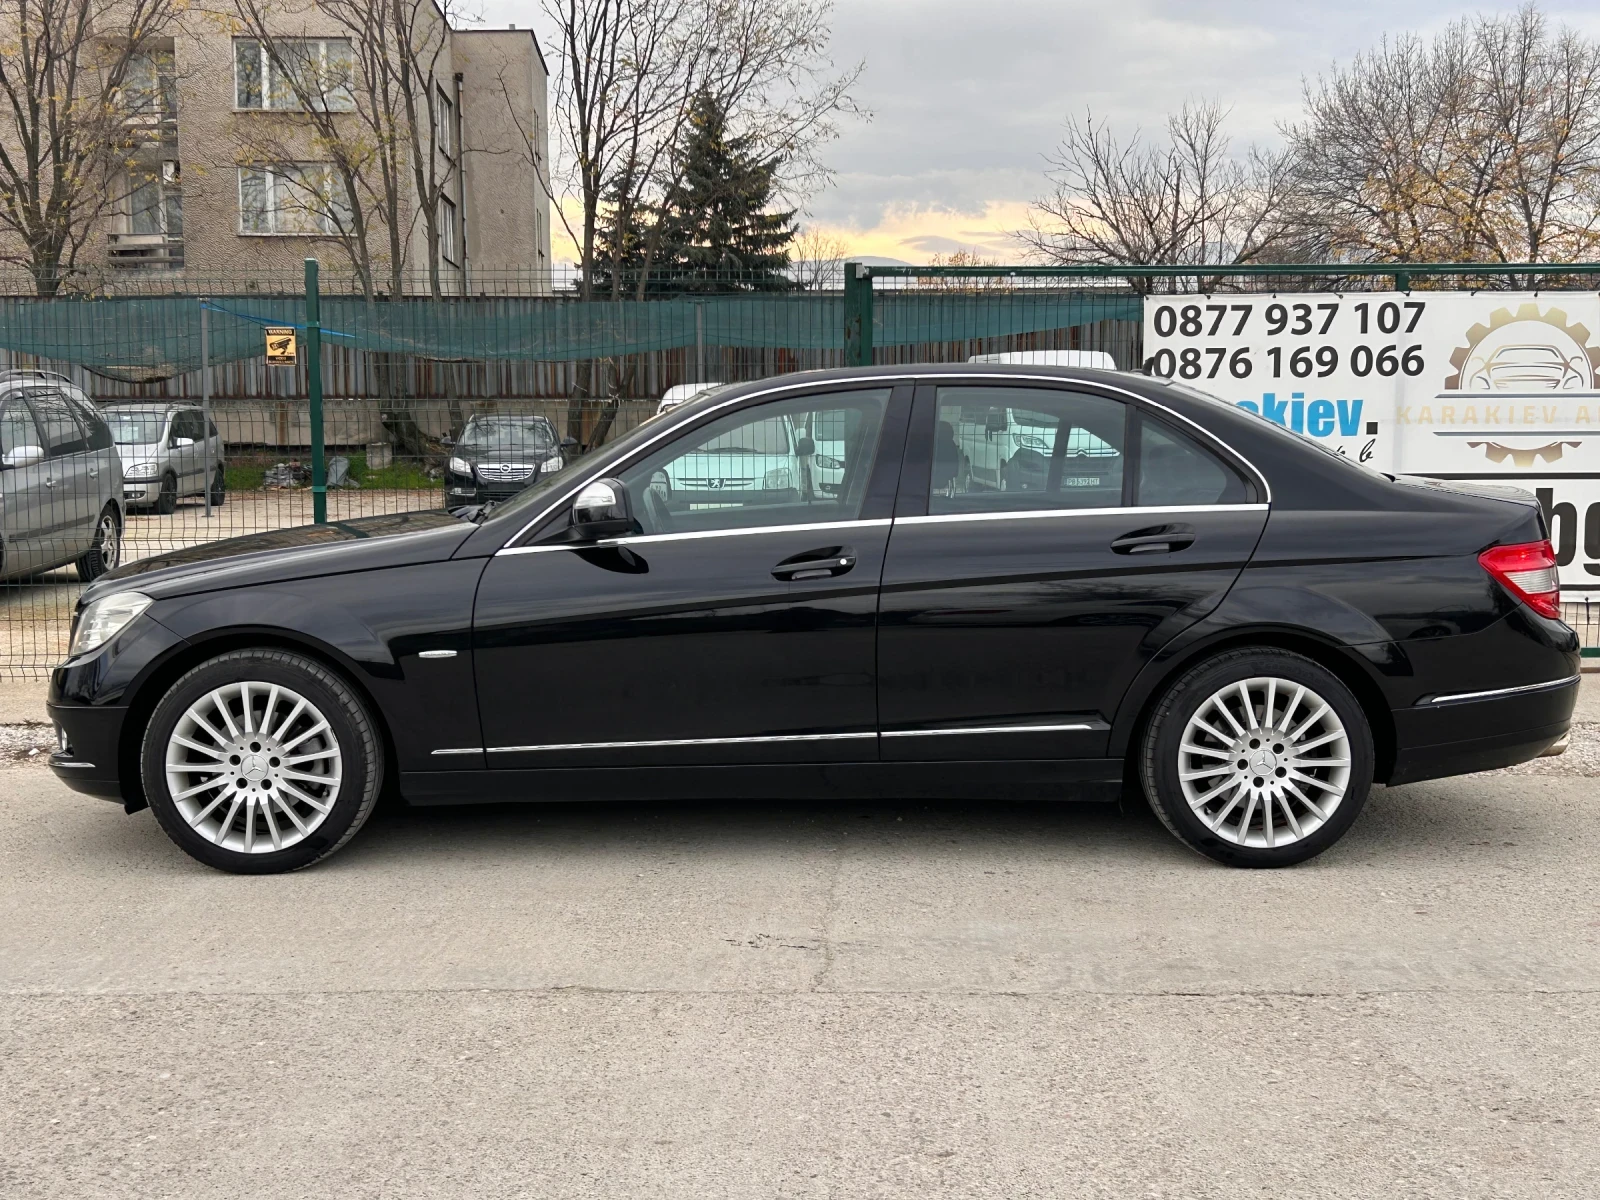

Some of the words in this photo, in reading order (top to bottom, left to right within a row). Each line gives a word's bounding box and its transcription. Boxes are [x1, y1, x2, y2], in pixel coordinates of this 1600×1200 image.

[1154, 304, 1253, 338] 0877
[1265, 303, 1340, 336] 937
[1354, 301, 1426, 335] 107
[1154, 346, 1253, 380] 0876
[1267, 345, 1339, 378] 169
[1350, 344, 1425, 378] 066
[1397, 405, 1557, 425] KARAKIEV
[1575, 405, 1600, 424] A
